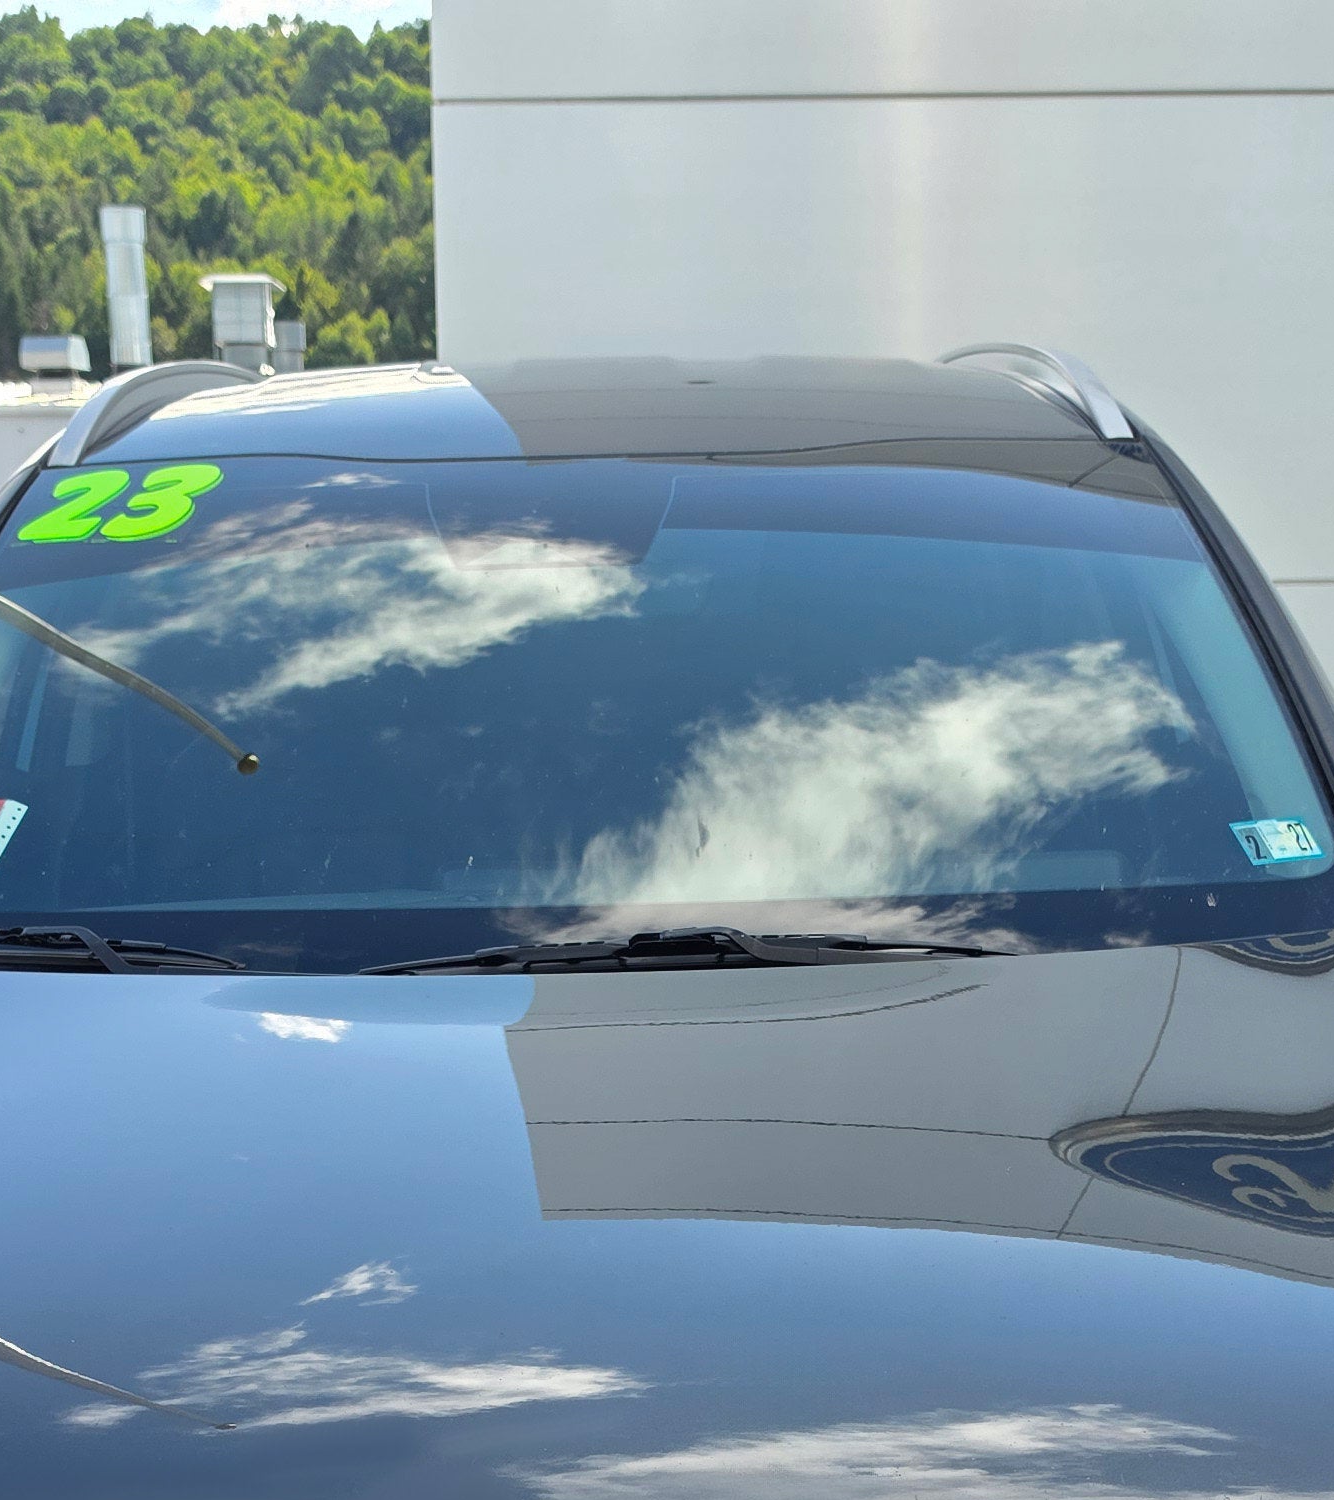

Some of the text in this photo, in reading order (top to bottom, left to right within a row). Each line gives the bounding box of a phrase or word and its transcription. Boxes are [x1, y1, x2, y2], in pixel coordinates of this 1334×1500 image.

[17, 464, 224, 543] 23
[1244, 822, 1313, 860] 2 27
